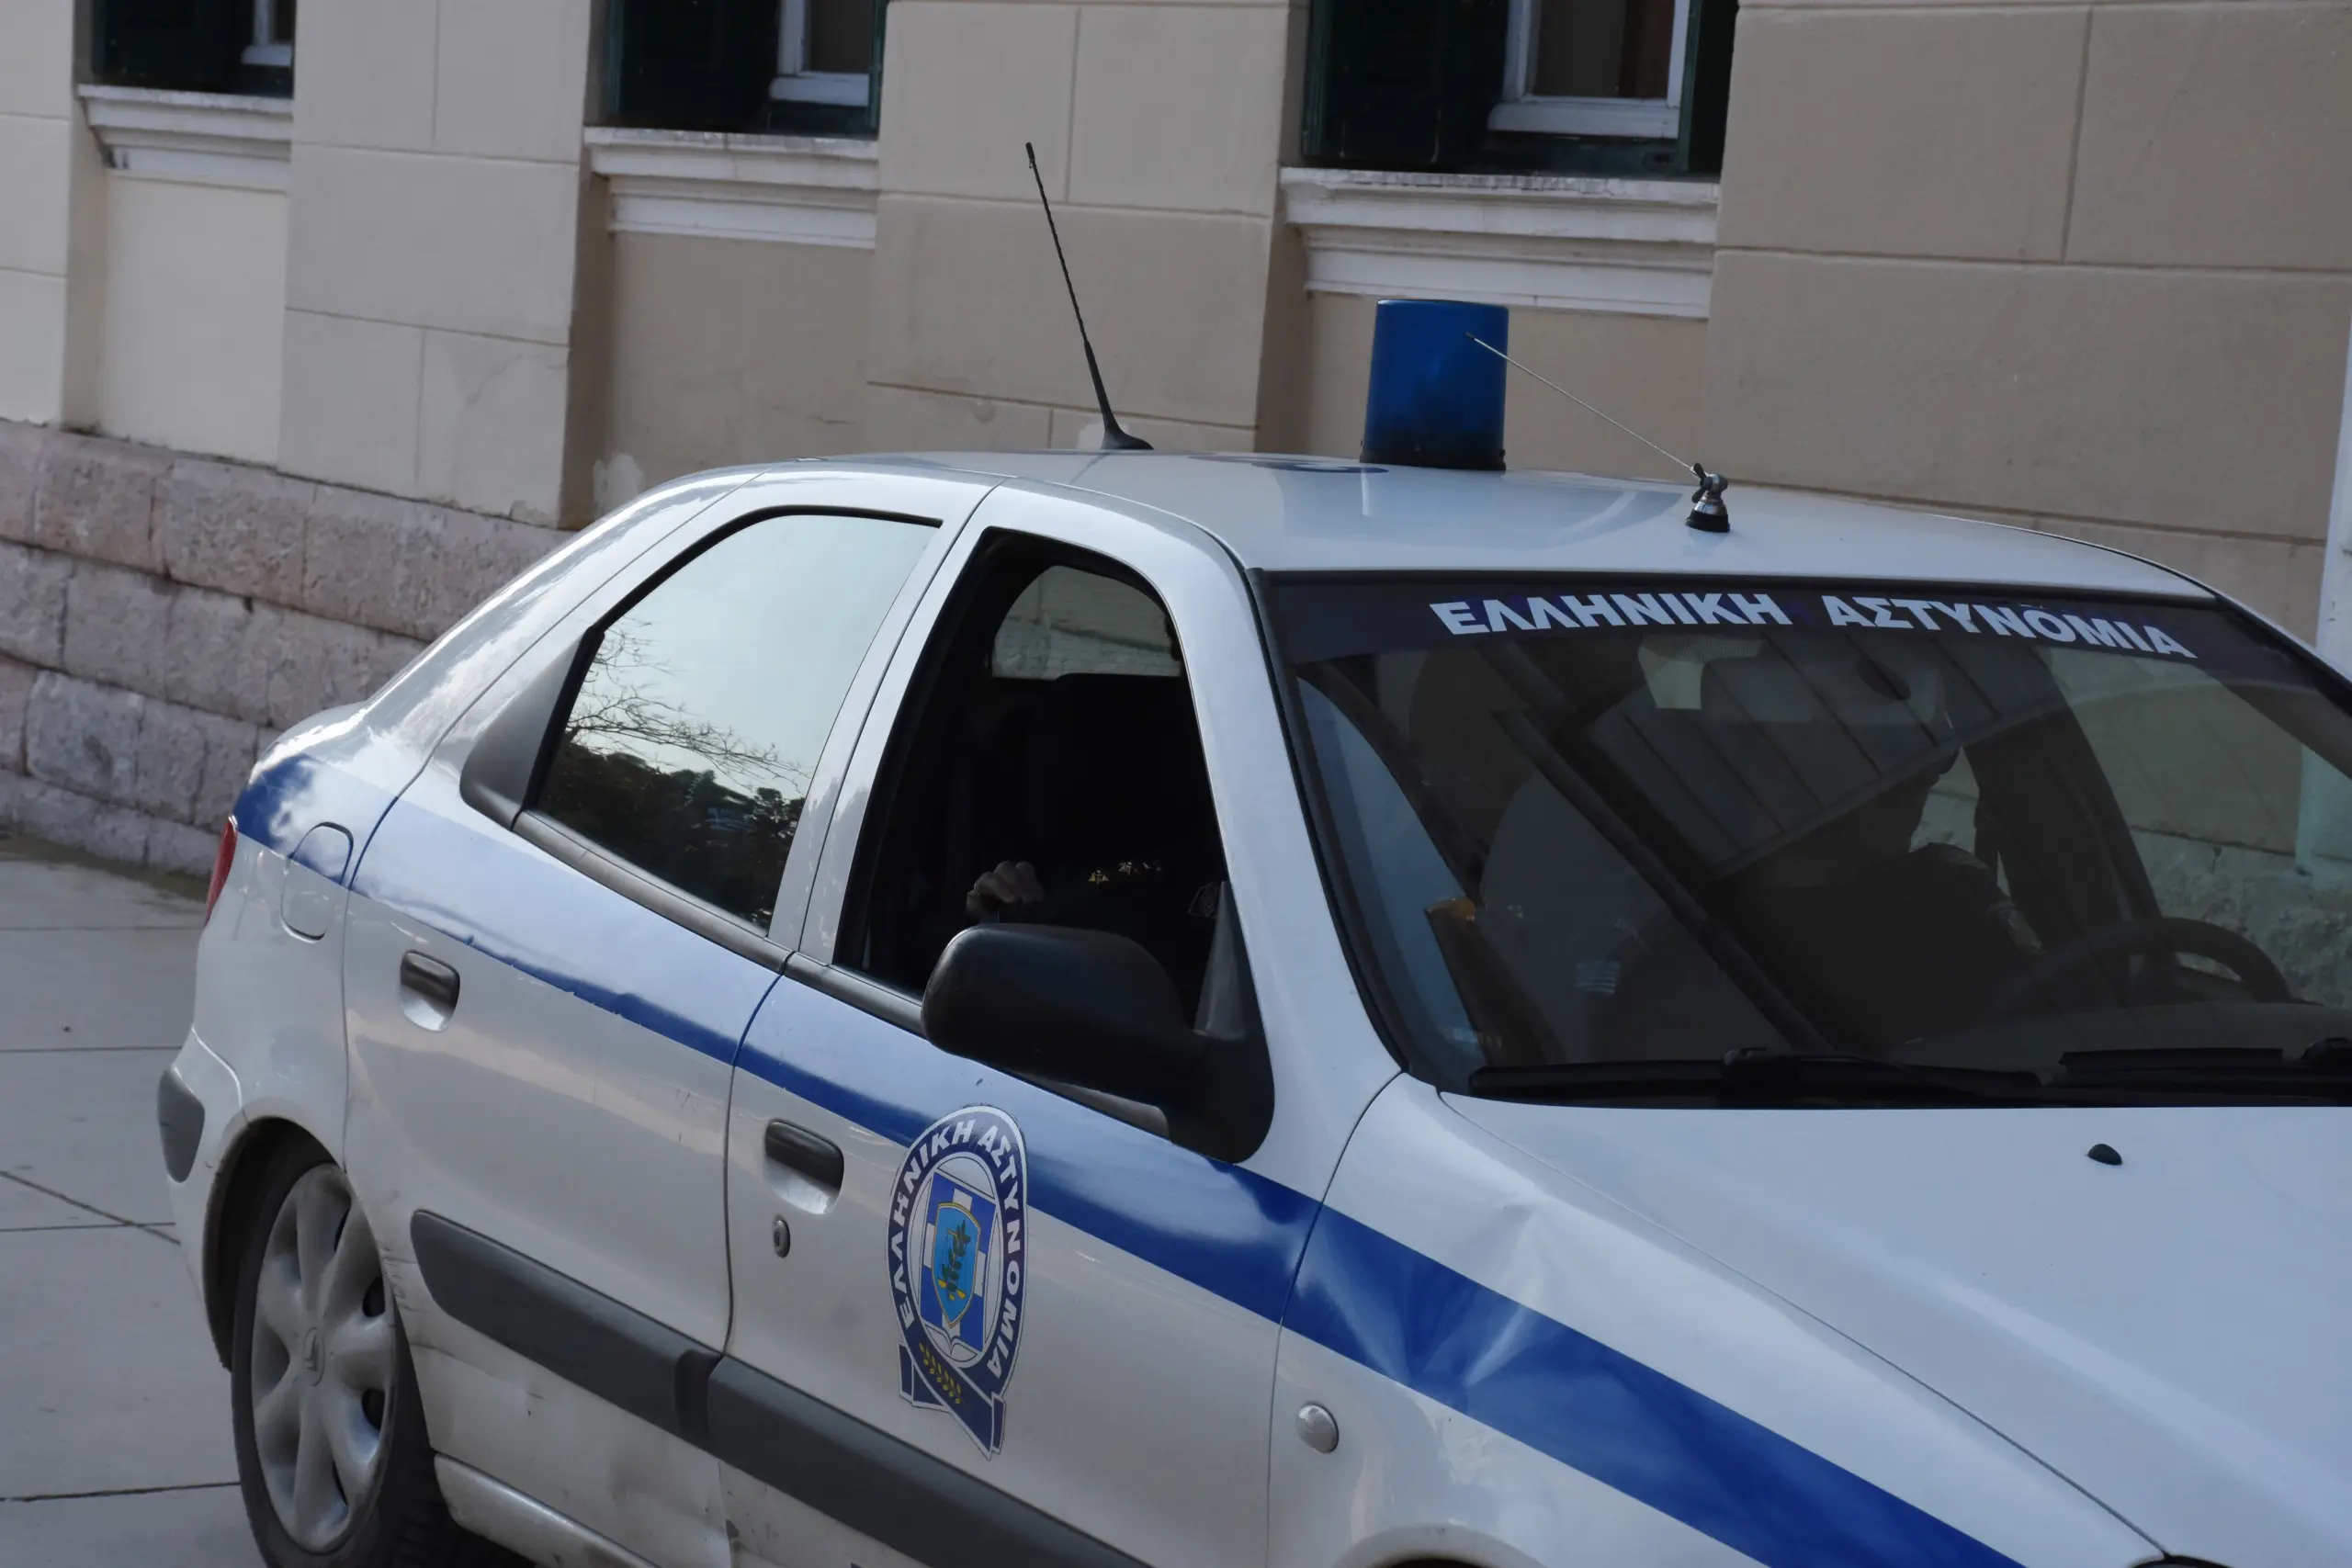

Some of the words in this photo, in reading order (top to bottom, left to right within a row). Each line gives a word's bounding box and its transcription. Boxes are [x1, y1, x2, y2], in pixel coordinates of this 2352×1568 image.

[1430, 592, 1792, 635] ΕΛΛΗΝΙΚΗ
[1821, 595, 2198, 659] ΑΣΤΥΝΟΜΙΑ
[891, 1120, 974, 1329] ΕΛΛΗΝΙΚΗ
[978, 1125, 1021, 1379] ΑΣΤΥΝΟΜΙΑ
